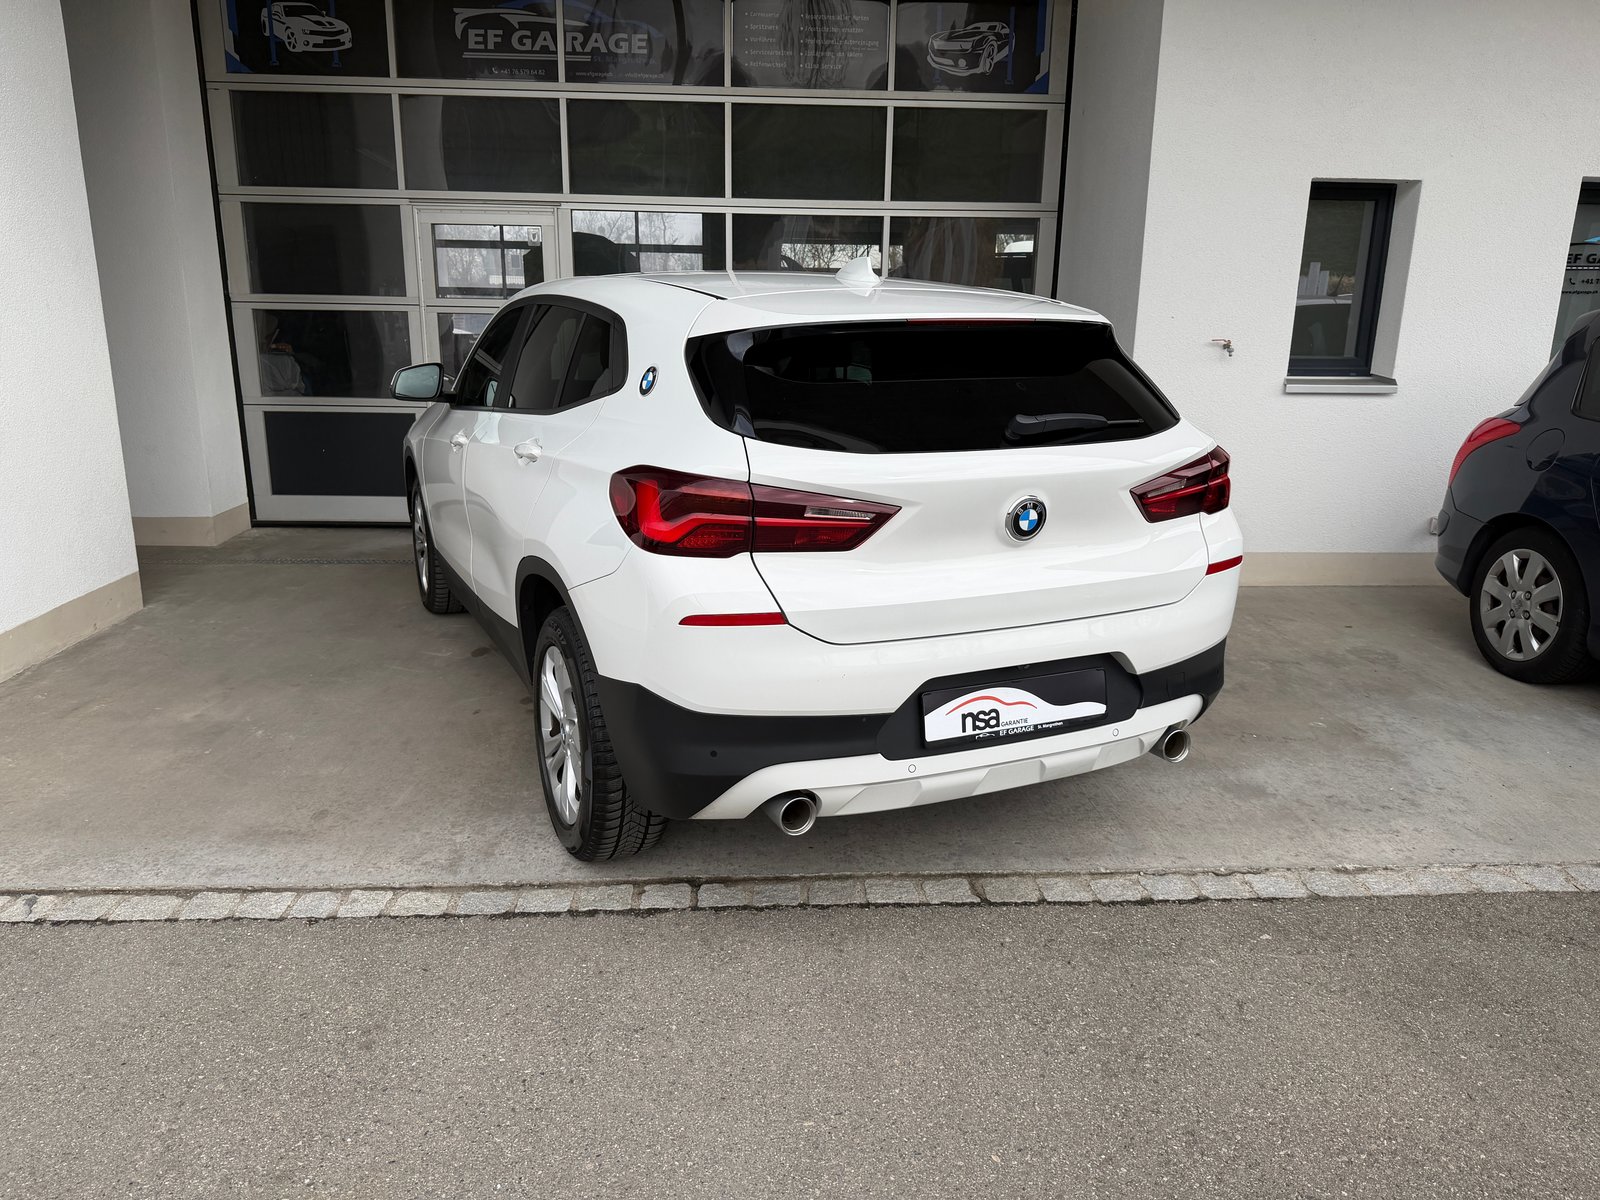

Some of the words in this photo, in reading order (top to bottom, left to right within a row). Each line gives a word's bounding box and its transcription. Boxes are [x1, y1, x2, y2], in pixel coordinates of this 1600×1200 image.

[468, 29, 503, 50] EF
[511, 30, 649, 54] GARAGE
[1017, 502, 1043, 515] BMW
[961, 708, 1000, 733] nsa
[1001, 718, 1029, 727] GARANTIE
[1008, 725, 1035, 735] GARAGE
